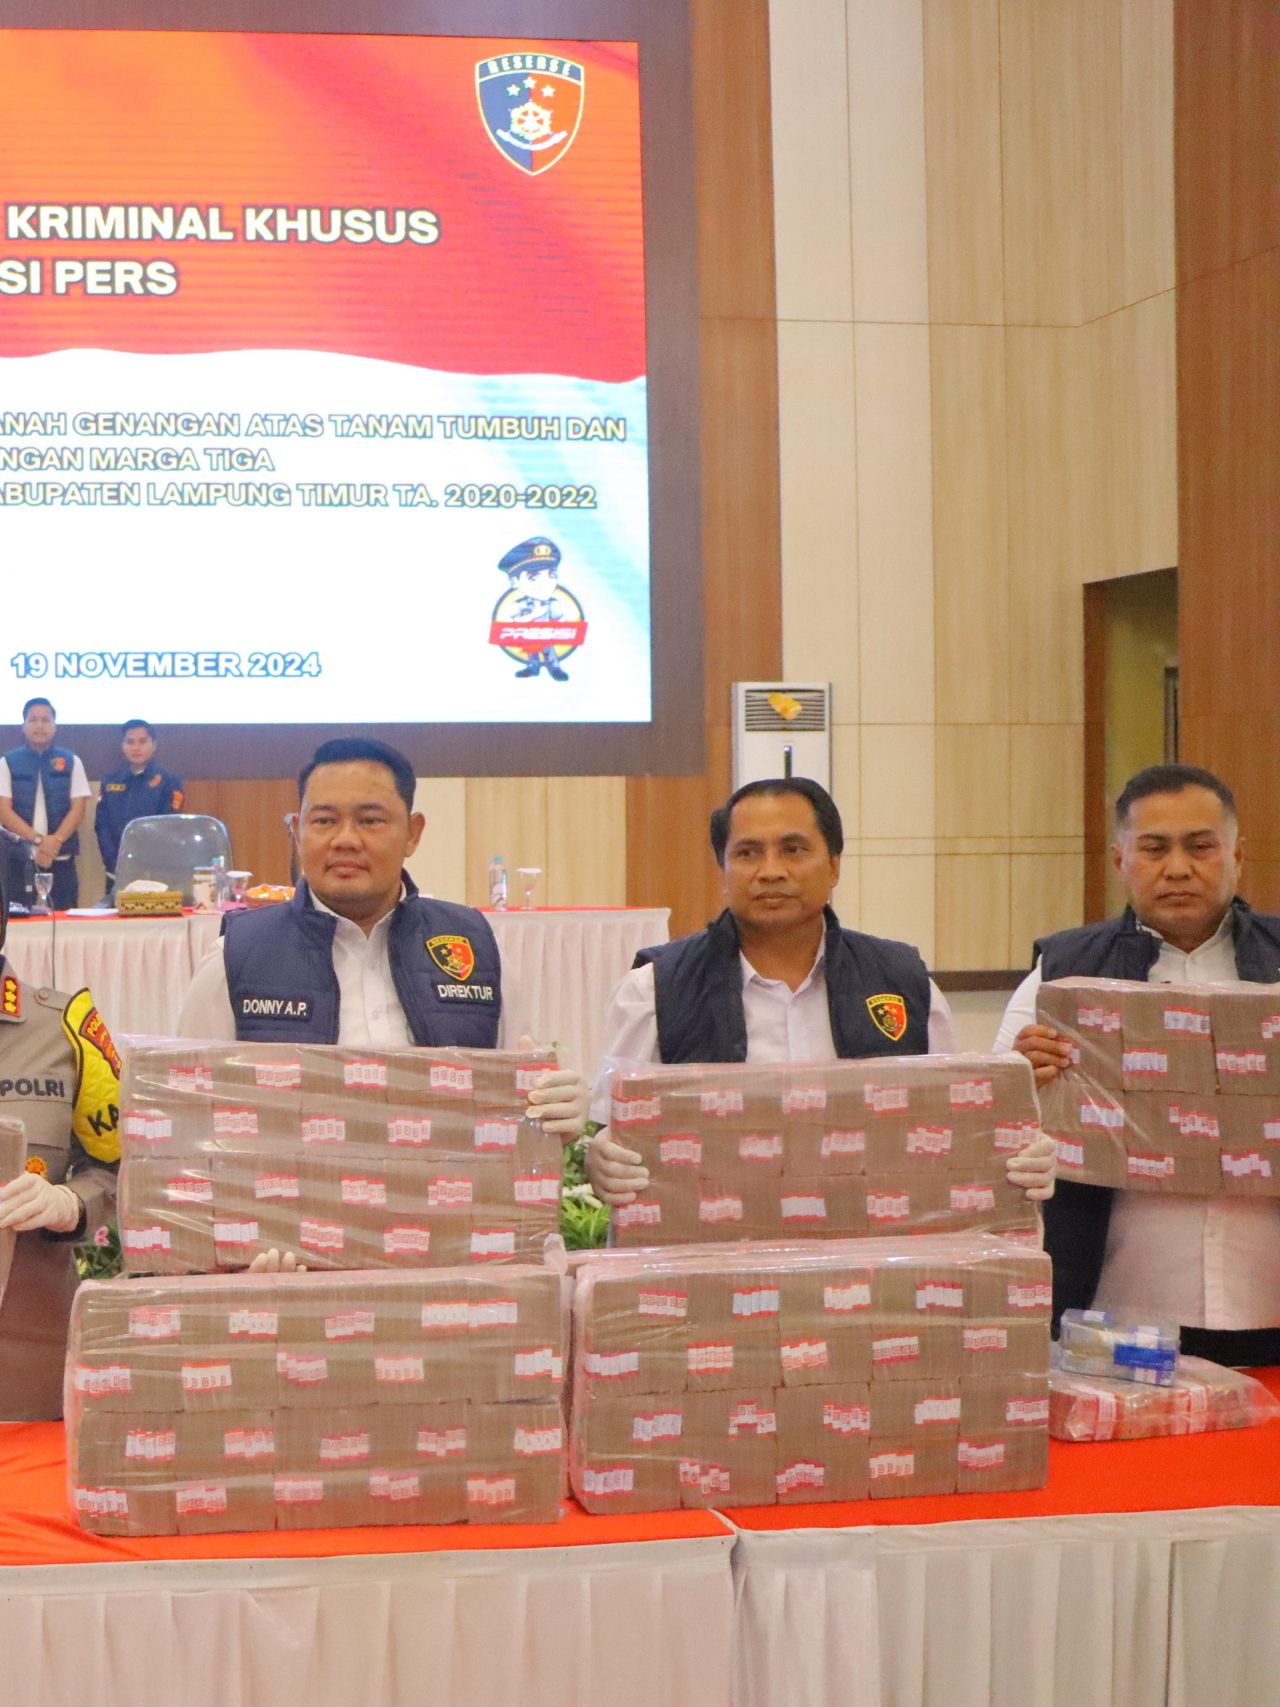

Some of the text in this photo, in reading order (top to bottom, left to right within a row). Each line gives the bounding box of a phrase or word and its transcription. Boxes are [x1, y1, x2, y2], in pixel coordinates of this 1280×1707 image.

[487, 55, 572, 76] RESERSE
[6, 204, 234, 241] KRIMINAL
[244, 207, 440, 244] KHUSUS
[54, 260, 179, 296] PERS
[73, 412, 240, 437] GENANGAN
[245, 413, 324, 437] ATAS
[329, 413, 433, 438] TANAM
[438, 415, 561, 440] TUMBUH
[566, 417, 626, 442] DAN
[90, 447, 200, 471] MARGA
[205, 448, 275, 471] TIGA
[147, 482, 291, 507] LAMPUNG
[297, 483, 389, 507] TIMUR
[393, 483, 438, 508] TA.
[445, 484, 597, 509] 2020-2022
[10, 652, 49, 678] 19
[55, 652, 244, 678] NOVEMBER
[247, 652, 322, 678] 2024
[437, 984, 494, 1000] DIREKTUR
[243, 998, 307, 1016] DONNY A.P.
